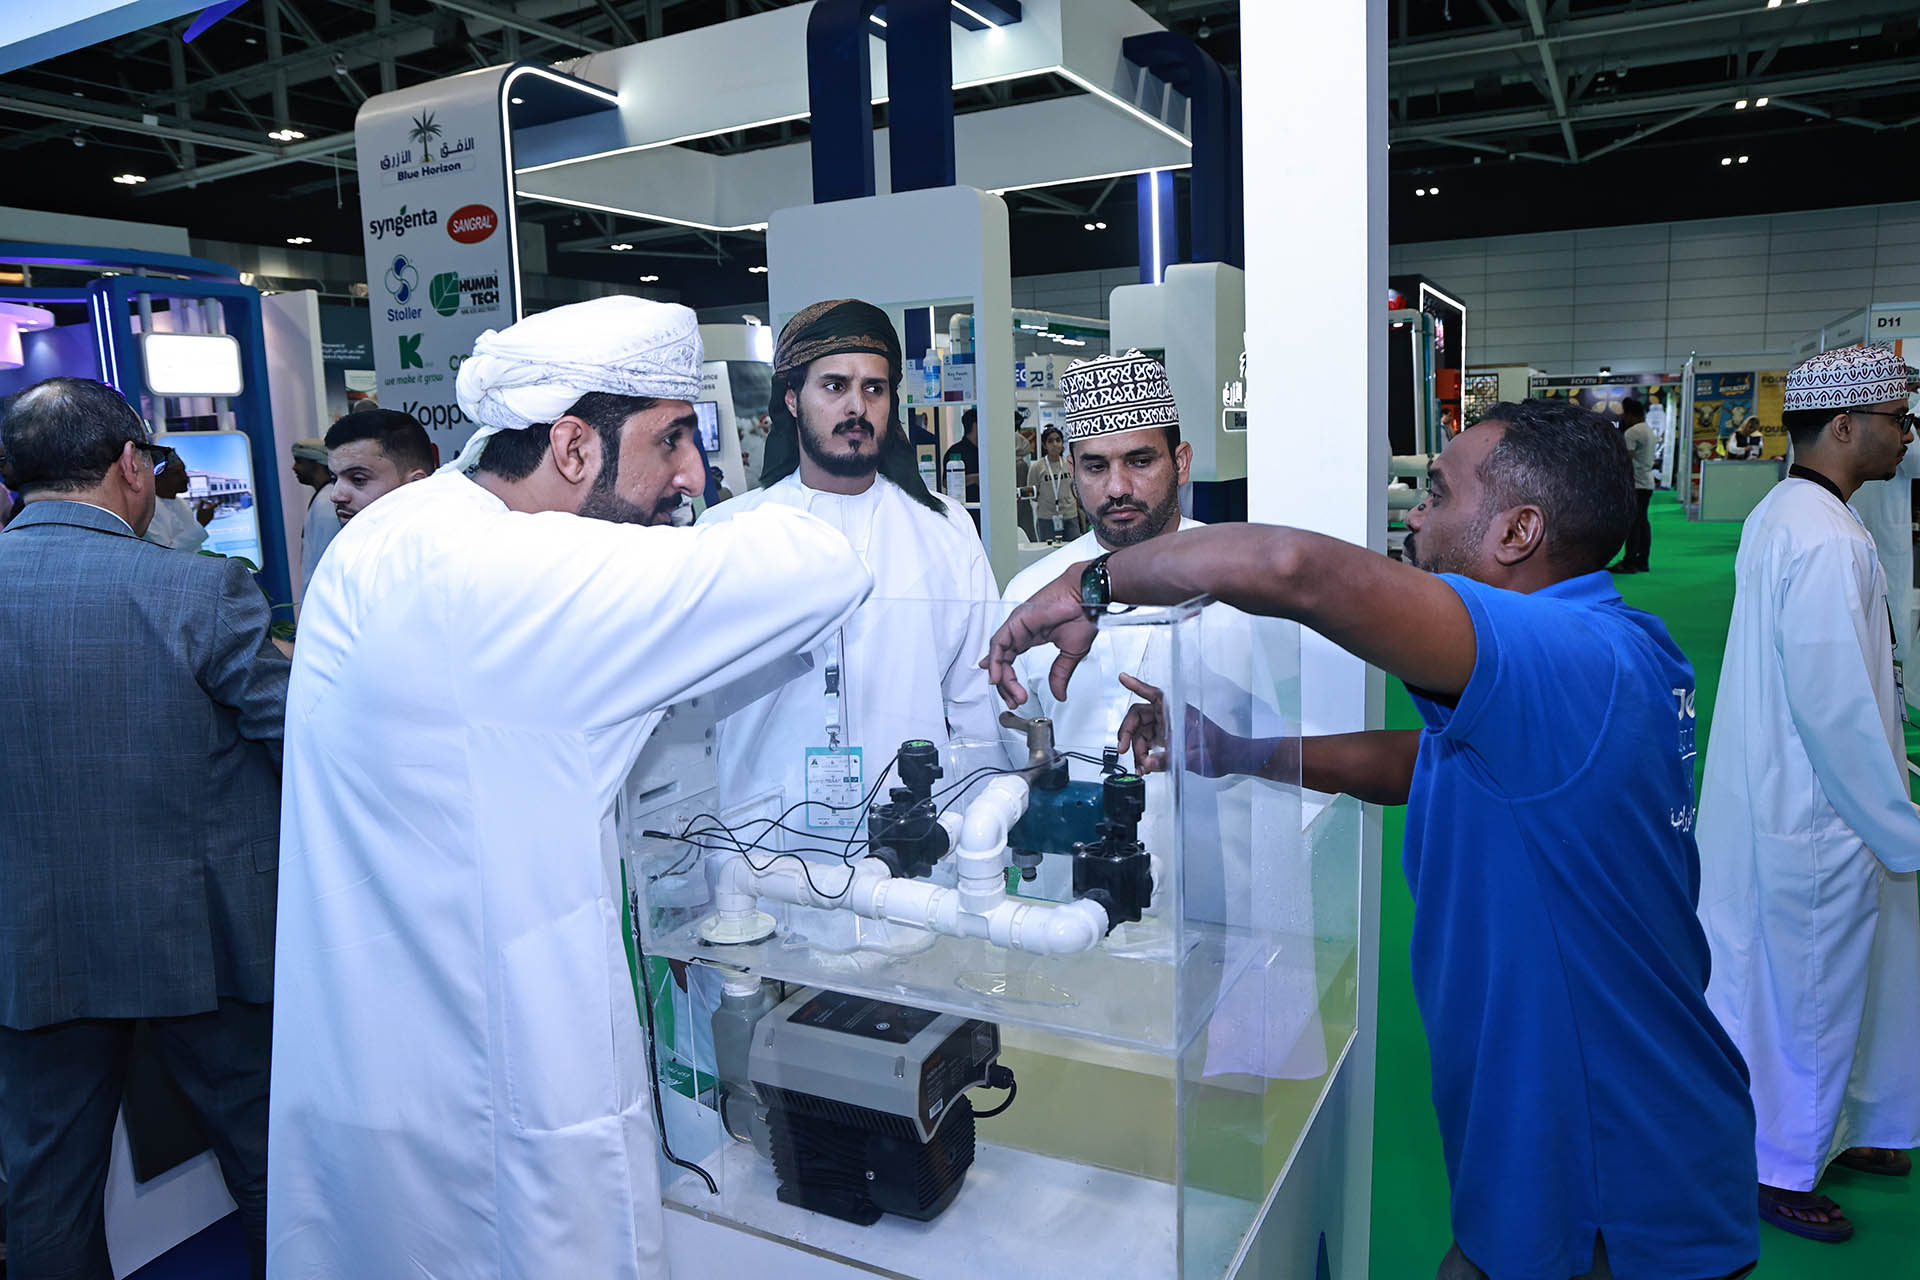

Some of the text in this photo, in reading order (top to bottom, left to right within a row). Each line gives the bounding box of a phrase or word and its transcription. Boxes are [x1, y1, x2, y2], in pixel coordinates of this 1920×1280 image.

[397, 161, 462, 181] Blue Horizon
[369, 207, 438, 240] syngenta
[452, 216, 493, 235] SANGRAL
[459, 275, 499, 293] HUMIN
[470, 291, 500, 306] TECH
[387, 306, 422, 322] Stoller
[1877, 317, 1902, 328] D11
[398, 333, 424, 370] K
[384, 373, 444, 385] we make it grow
